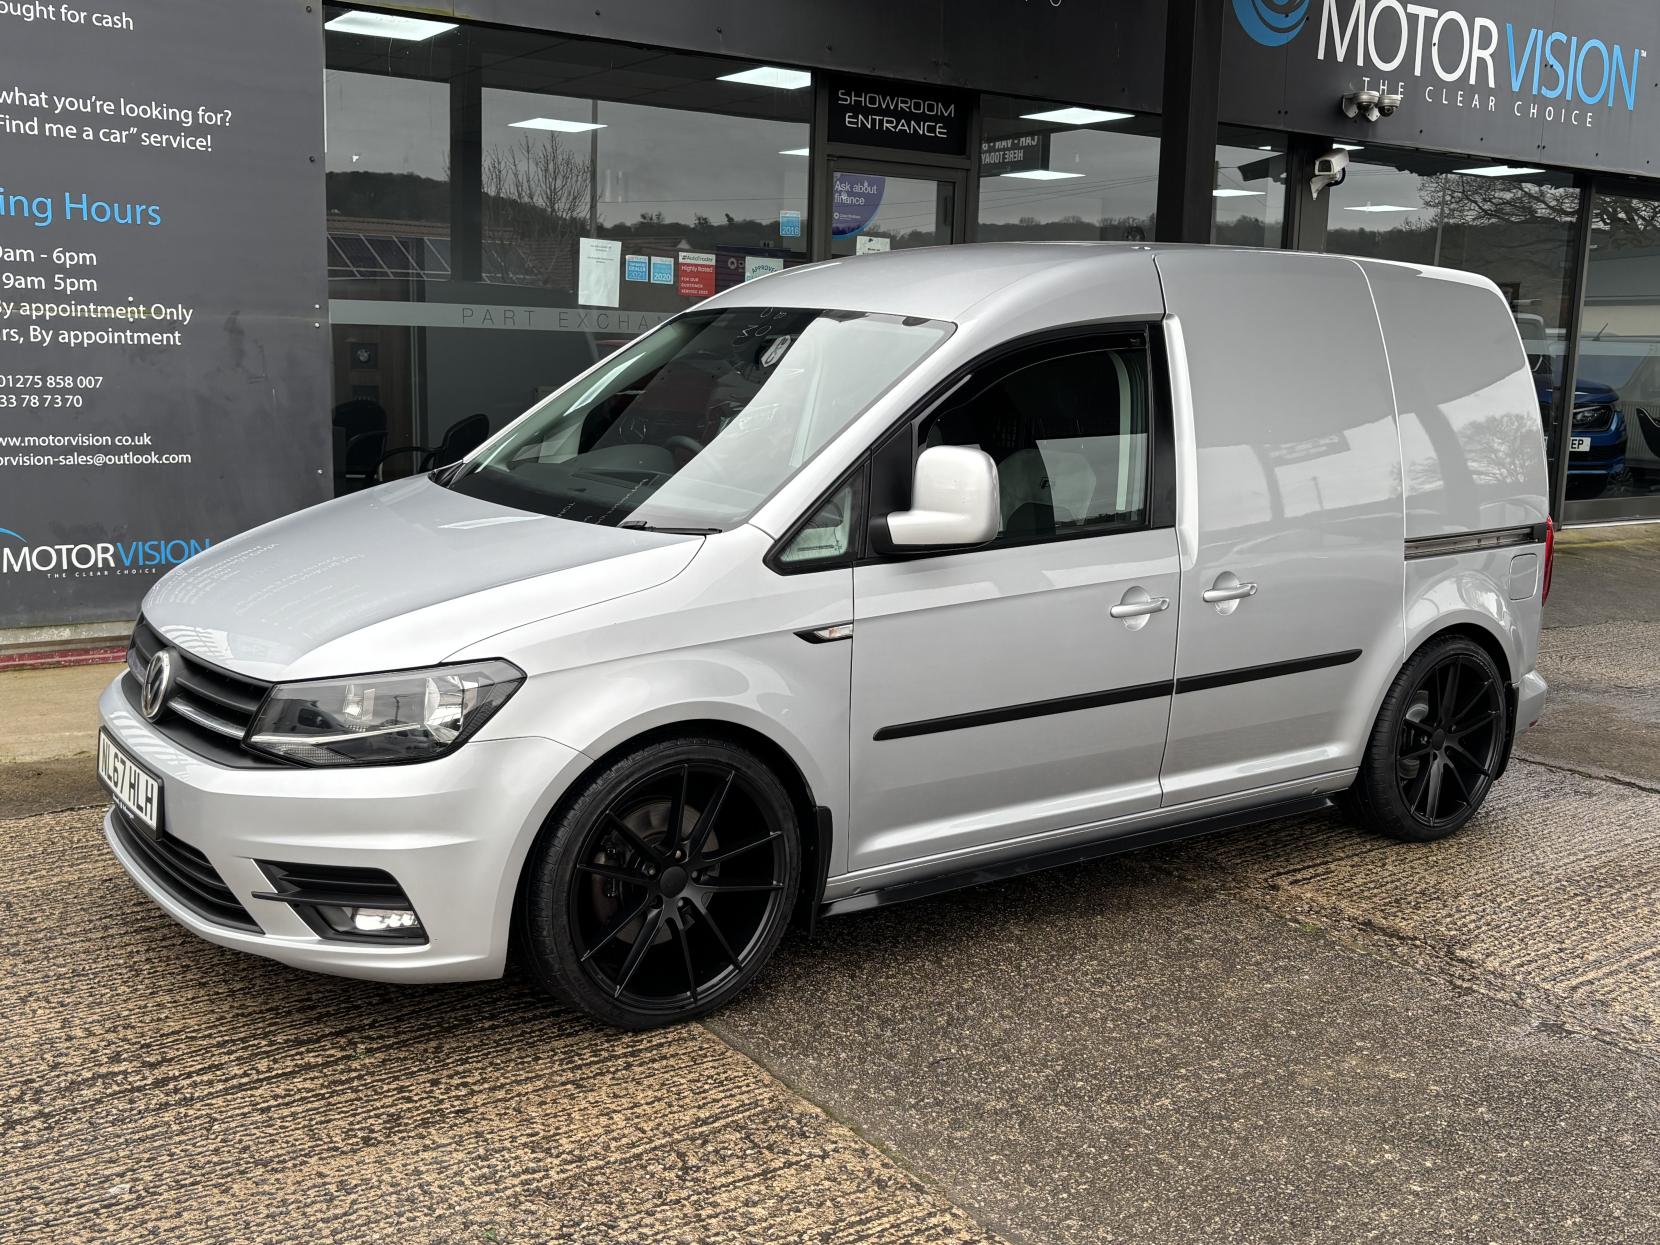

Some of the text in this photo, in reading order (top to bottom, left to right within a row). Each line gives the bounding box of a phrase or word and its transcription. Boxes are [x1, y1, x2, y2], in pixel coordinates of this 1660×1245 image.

[0, 0, 134, 30] ought for cash
[0, 87, 232, 127] what you're looking for?
[838, 90, 954, 118] SHOWROOM
[1362, 77, 1593, 127] THE CLEAR CHOICE
[45, 123, 77, 138] me
[83, 127, 94, 140] a
[141, 133, 212, 151] service!
[845, 113, 948, 138] ENTRANCE
[834, 180, 877, 194] Ask about
[0, 187, 161, 226] ing Hours
[834, 193, 865, 206] finance
[0, 246, 35, 262] am
[53, 248, 97, 268] 6pm
[654, 273, 671, 281] 2020
[752, 265, 778, 274] APPROVE
[2, 273, 97, 294] 9am 5pm
[0, 299, 194, 325] y appointment Only
[462, 307, 663, 331] PART EXCHA
[30, 326, 53, 346] By
[59, 328, 181, 348] appointment
[0, 375, 104, 389] 01275 858 007
[101, 737, 127, 794] NL67
[128, 765, 154, 822] HLH
